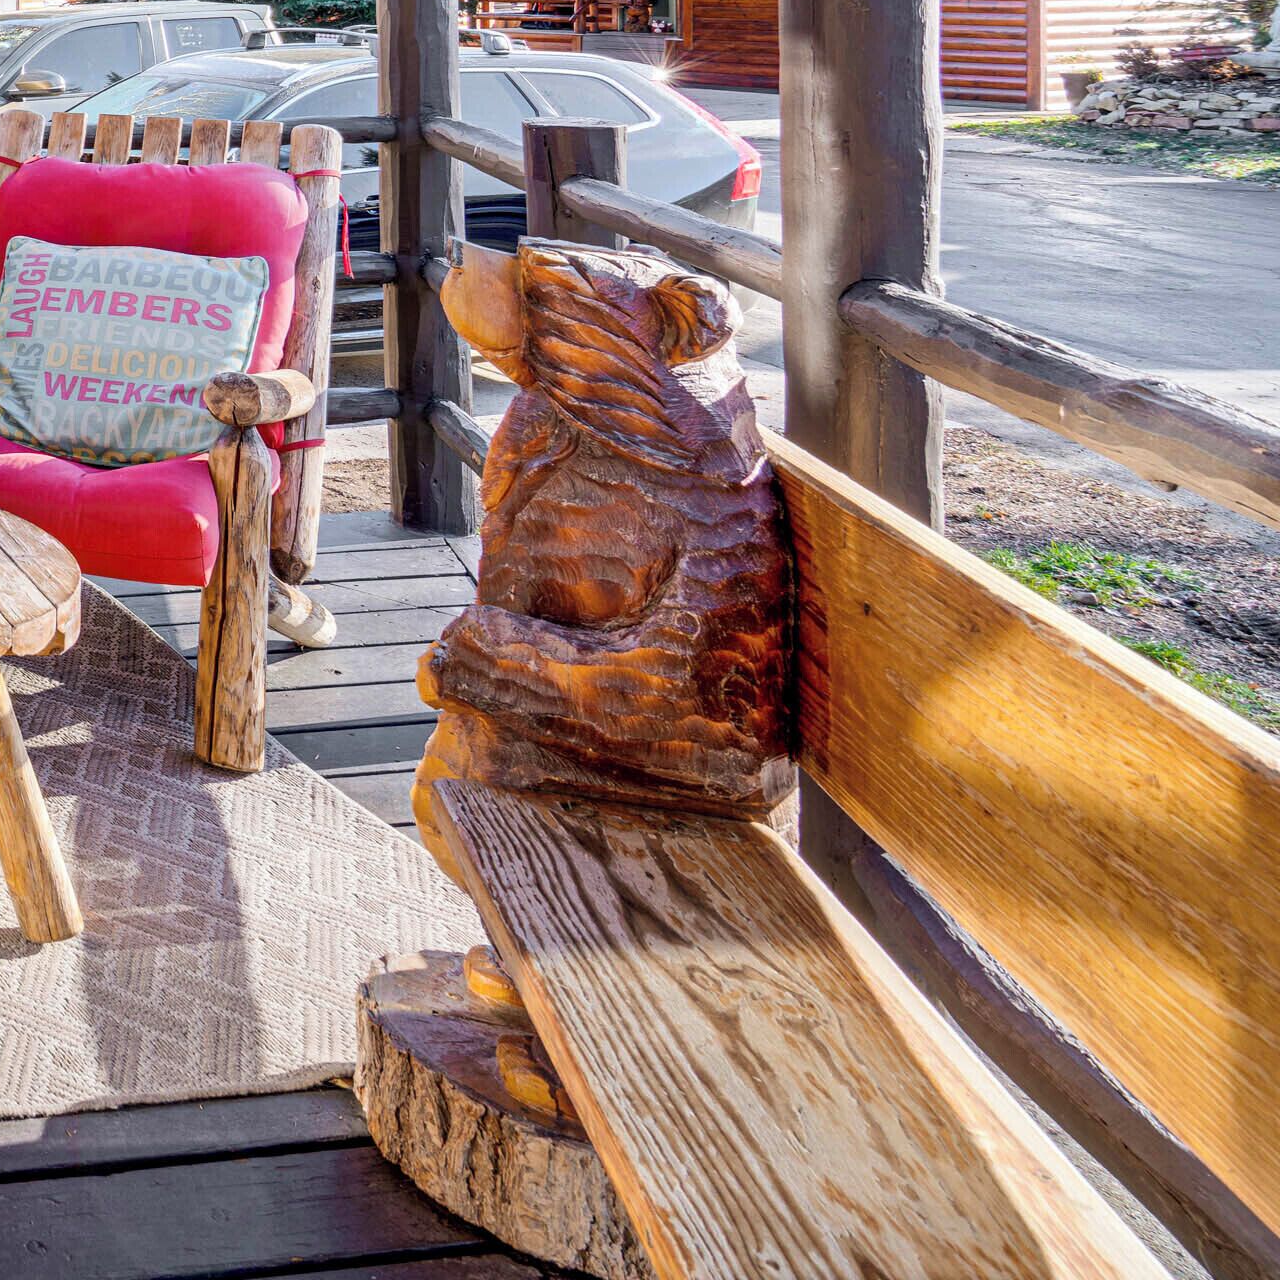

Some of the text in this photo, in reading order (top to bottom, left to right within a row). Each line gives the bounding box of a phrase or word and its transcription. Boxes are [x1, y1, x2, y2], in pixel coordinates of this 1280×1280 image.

[5, 253, 53, 338] LAUGH
[48, 255, 254, 303] BARBEQU
[40, 287, 233, 332] EMBERS
[36, 316, 227, 361] FRIENDS
[46, 341, 210, 381] DELICIOU
